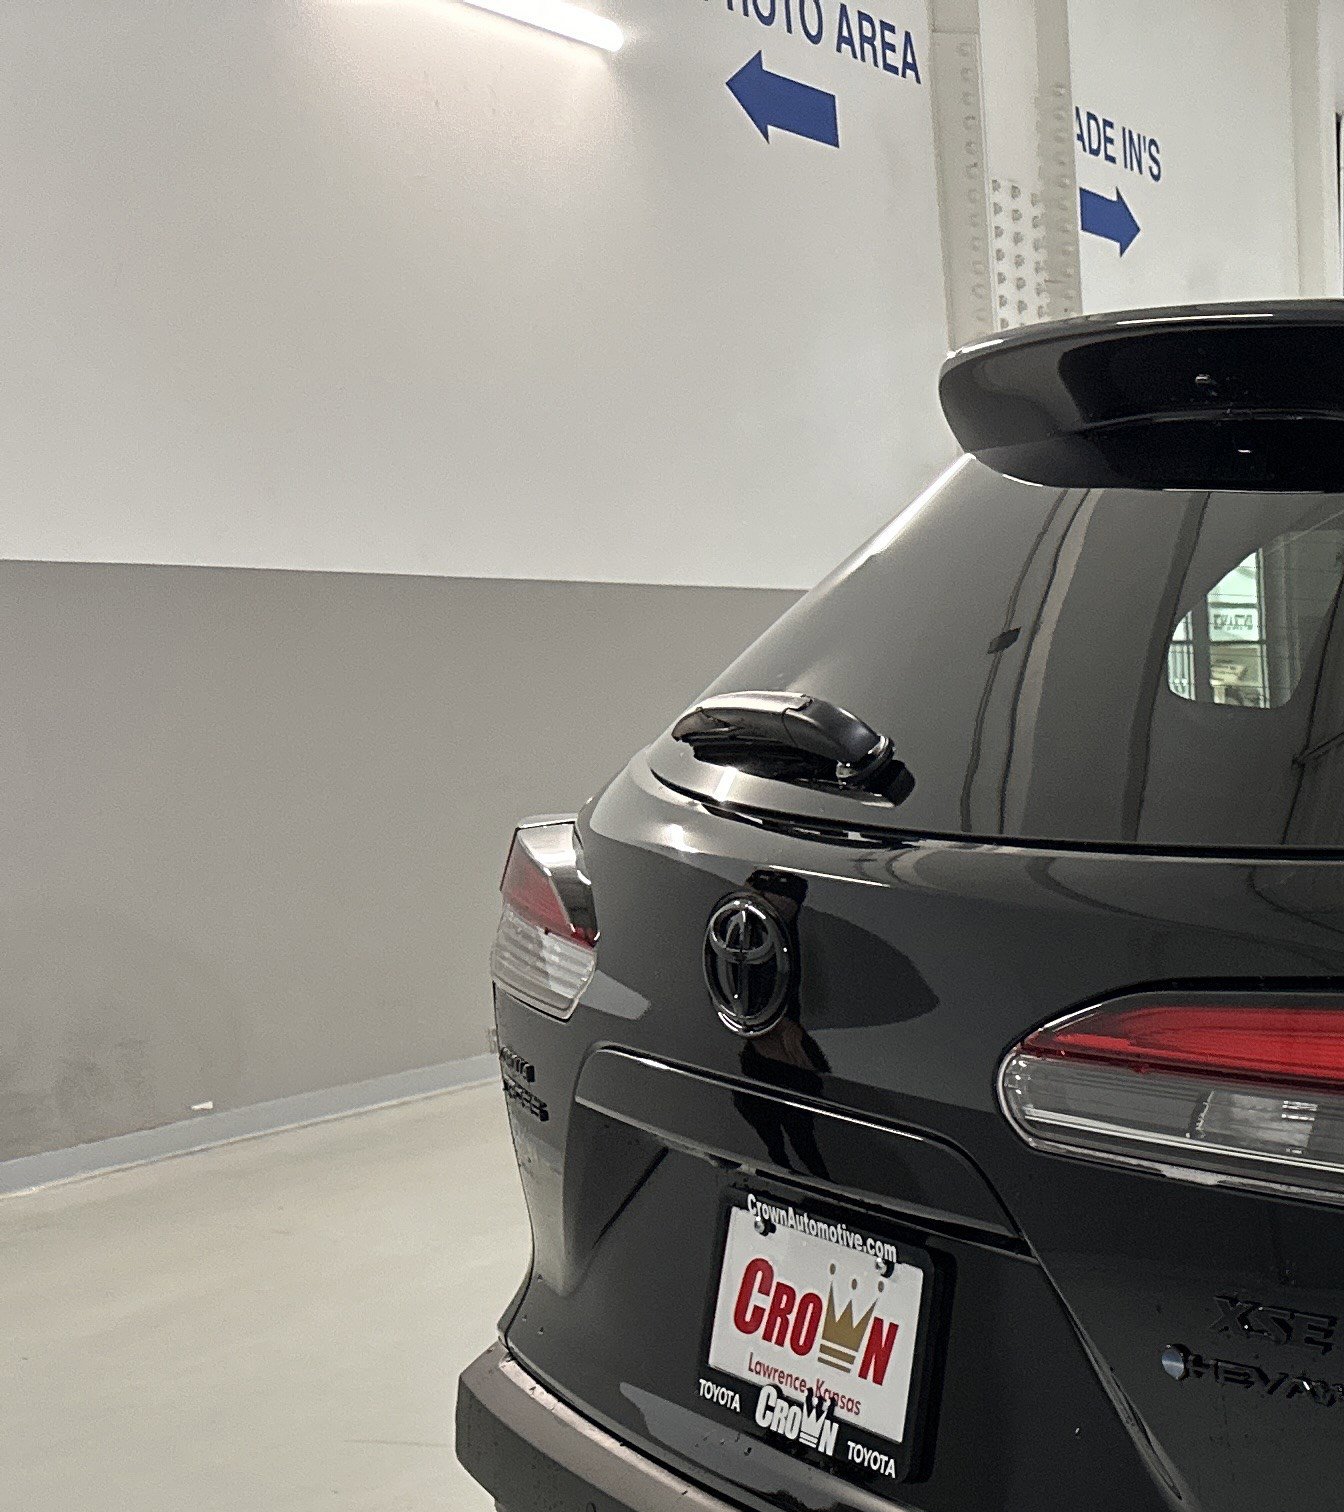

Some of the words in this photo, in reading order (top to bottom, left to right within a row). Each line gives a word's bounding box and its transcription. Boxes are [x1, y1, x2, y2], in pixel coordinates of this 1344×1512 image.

[836, 3, 922, 85] AREA
[1122, 126, 1162, 183] IN'S
[747, 1193, 897, 1263] CrownAutomotive.com
[733, 1258, 899, 1386] CROWN
[1210, 1294, 1339, 1356] XSE
[699, 1379, 741, 1412] TOYOTA
[755, 1384, 839, 1456] CROWN
[847, 1440, 896, 1479] TOYOTA
